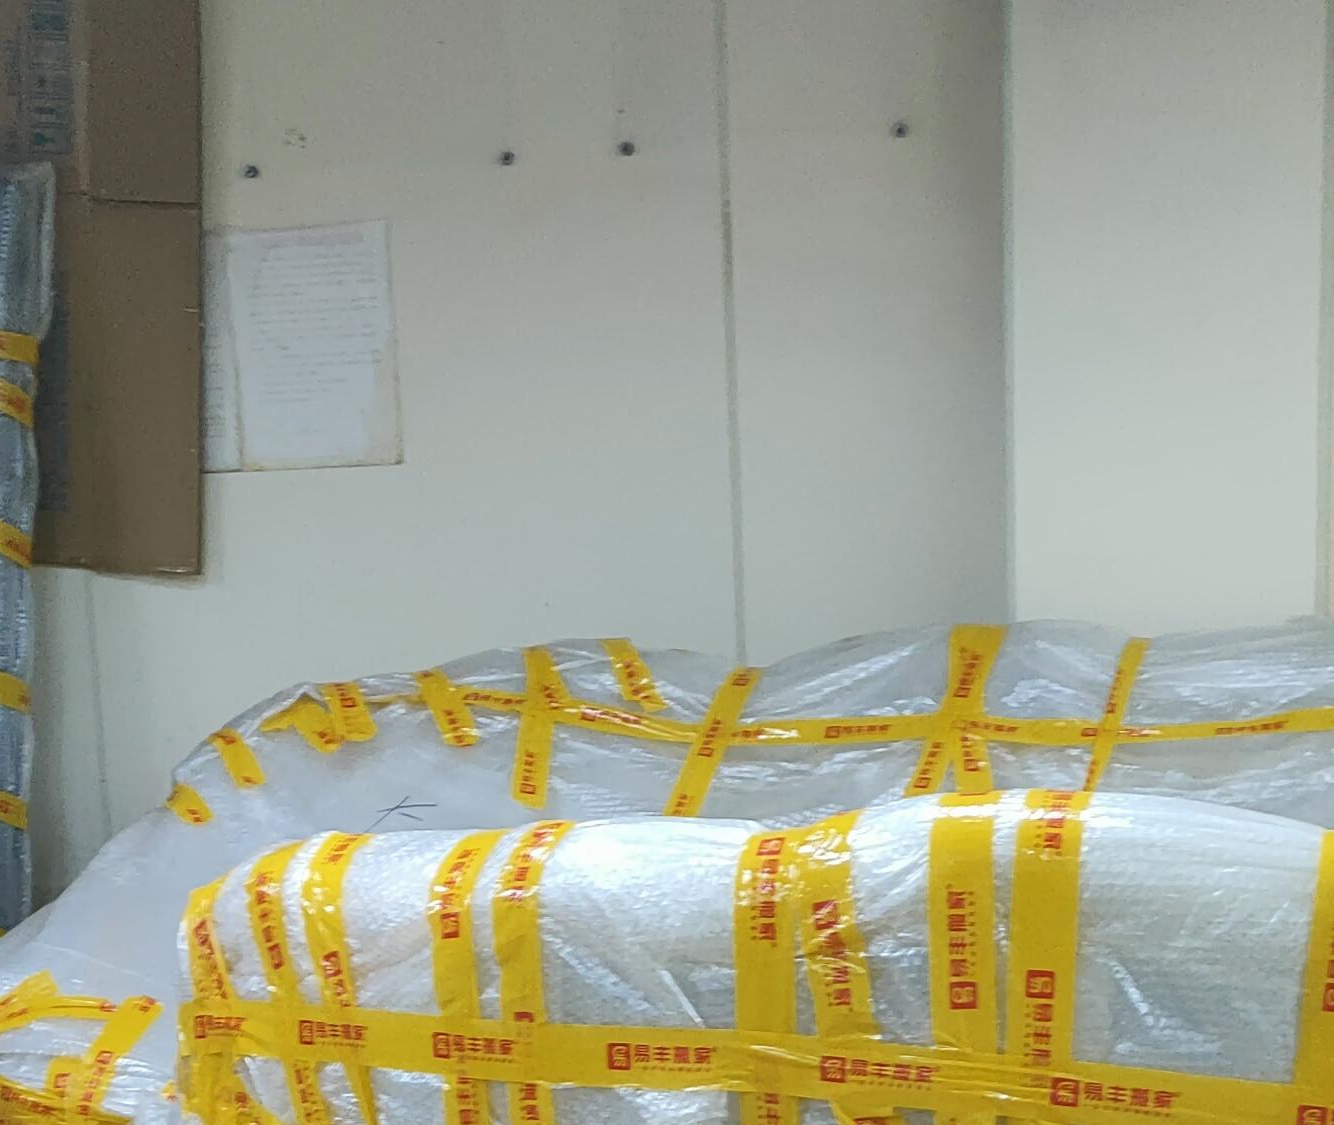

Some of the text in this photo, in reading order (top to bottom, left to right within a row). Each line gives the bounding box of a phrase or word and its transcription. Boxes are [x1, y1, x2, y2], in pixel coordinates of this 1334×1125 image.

[634, 1045, 713, 1066] 易丰搬家
[1083, 1081, 1173, 1110] 易丰搬家
